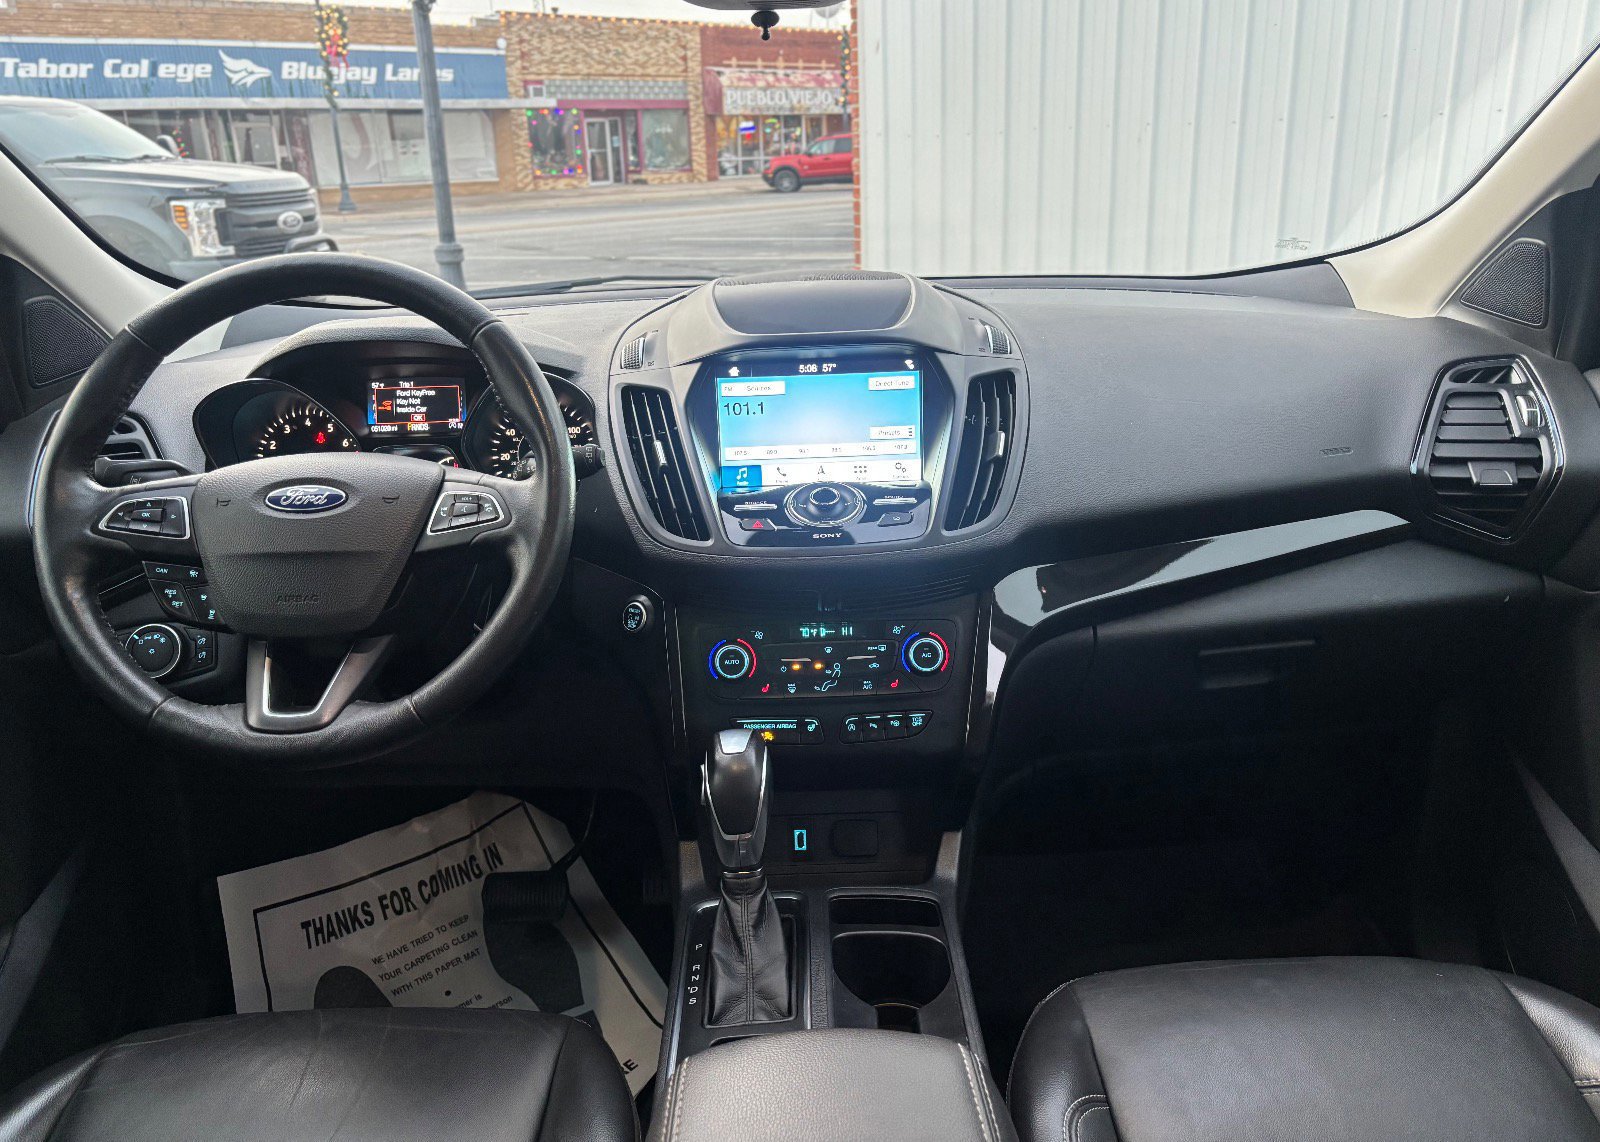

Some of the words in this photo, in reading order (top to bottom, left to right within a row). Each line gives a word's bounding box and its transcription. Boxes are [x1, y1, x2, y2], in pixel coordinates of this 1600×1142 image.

[0, 57, 94, 78] Tabor
[727, 90, 787, 105] PUEBLO
[789, 91, 833, 104] VIEJO
[799, 364, 818, 373] 5:08
[822, 363, 837, 372] 57°
[411, 389, 436, 397] KeyFree
[396, 398, 409, 406] Key
[723, 402, 765, 416] 101.1
[304, 417, 311, 427] 4
[284, 424, 290, 434] 3
[327, 423, 333, 432] 5
[567, 426, 580, 434] 100
[505, 428, 516, 437] 40
[270, 441, 276, 450] 2
[342, 438, 349, 447] 6
[500, 453, 511, 461] 20
[301, 900, 375, 949] THANKS
[378, 886, 418, 921] FOR
[417, 854, 484, 905] COMING
[482, 842, 504, 872] IN
[371, 954, 386, 965] WE
[385, 944, 410, 960] HAVE
[409, 931, 435, 949] TRIED
[435, 924, 447, 935] TO
[448, 914, 469, 929] KEEP
[695, 943, 703, 951] P
[378, 967, 403, 983] YOUR
[403, 942, 450, 972] CARPETING
[451, 929, 479, 946] CLEAN
[390, 981, 415, 998] WITH
[414, 971, 434, 987] THIS
[434, 956, 463, 976] PAPER
[463, 947, 481, 961] MAT
[692, 964, 701, 972] R
[691, 974, 700, 982] N
[689, 986, 699, 994] D
[688, 997, 697, 1005] S
